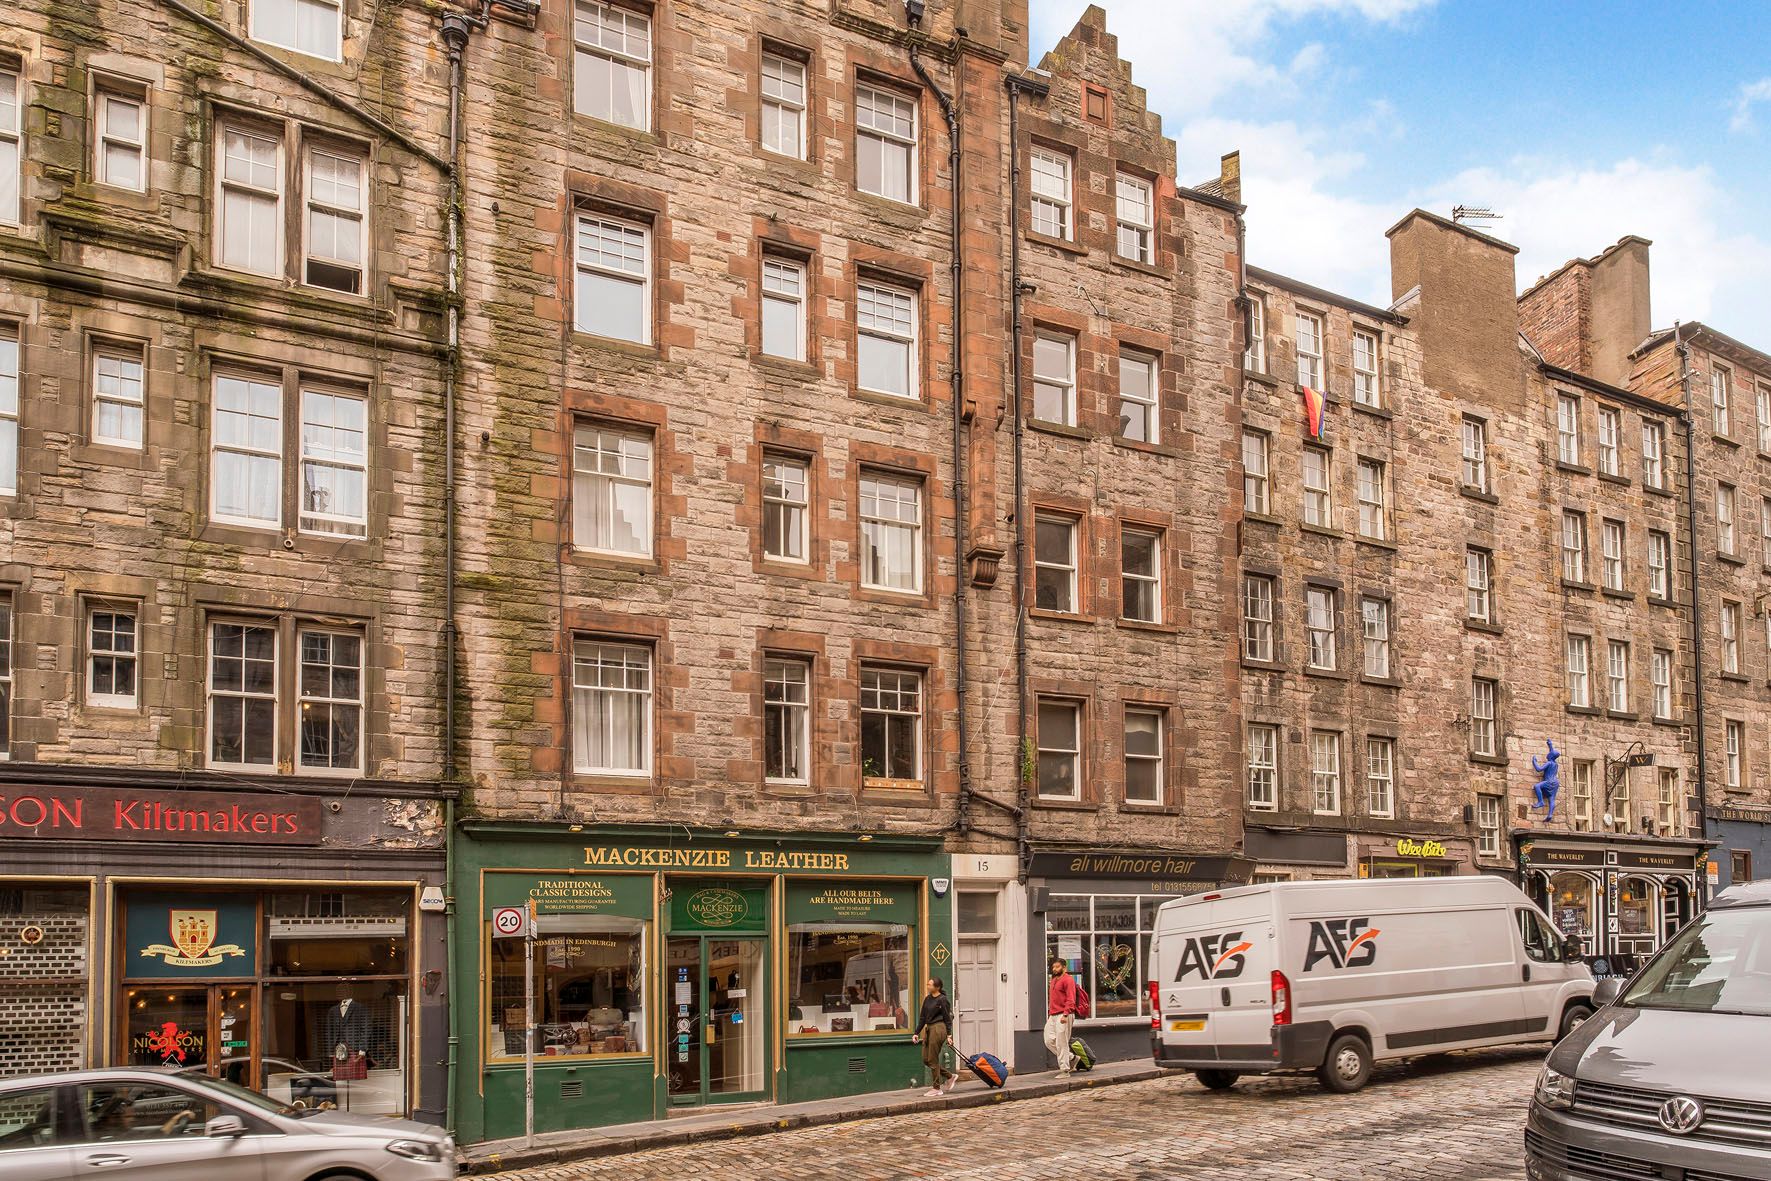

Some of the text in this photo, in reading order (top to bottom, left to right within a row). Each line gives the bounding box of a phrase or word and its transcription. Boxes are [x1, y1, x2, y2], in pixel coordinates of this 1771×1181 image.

[1635, 756, 1648, 764] W
[114, 800, 298, 834] Kiltmakers
[1722, 810, 1736, 818] THE
[1397, 839, 1447, 857] Wee Bite
[584, 847, 849, 870] MACKENZIE LEATHER
[978, 861, 989, 872] 15
[1093, 856, 1161, 873] willmore
[1164, 857, 1196, 874] hair
[538, 881, 604, 889] TRADITIONAL
[1151, 882, 1162, 891] tel
[529, 888, 612, 897] CLASSIC DESIGNS
[858, 890, 881, 898] BELTS
[809, 896, 826, 904] ARE
[692, 904, 743, 912] MACKENZIE
[500, 916, 518, 927] 20
[525, 938, 565, 947] NDMADE
[574, 939, 616, 947] EDINBURGH
[1303, 918, 1376, 972] AFS
[936, 949, 945, 959] 17
[1174, 931, 1246, 982] AFS
[134, 1036, 203, 1048] NICOLSON
[134, 1046, 203, 1054] KILTMAERS
